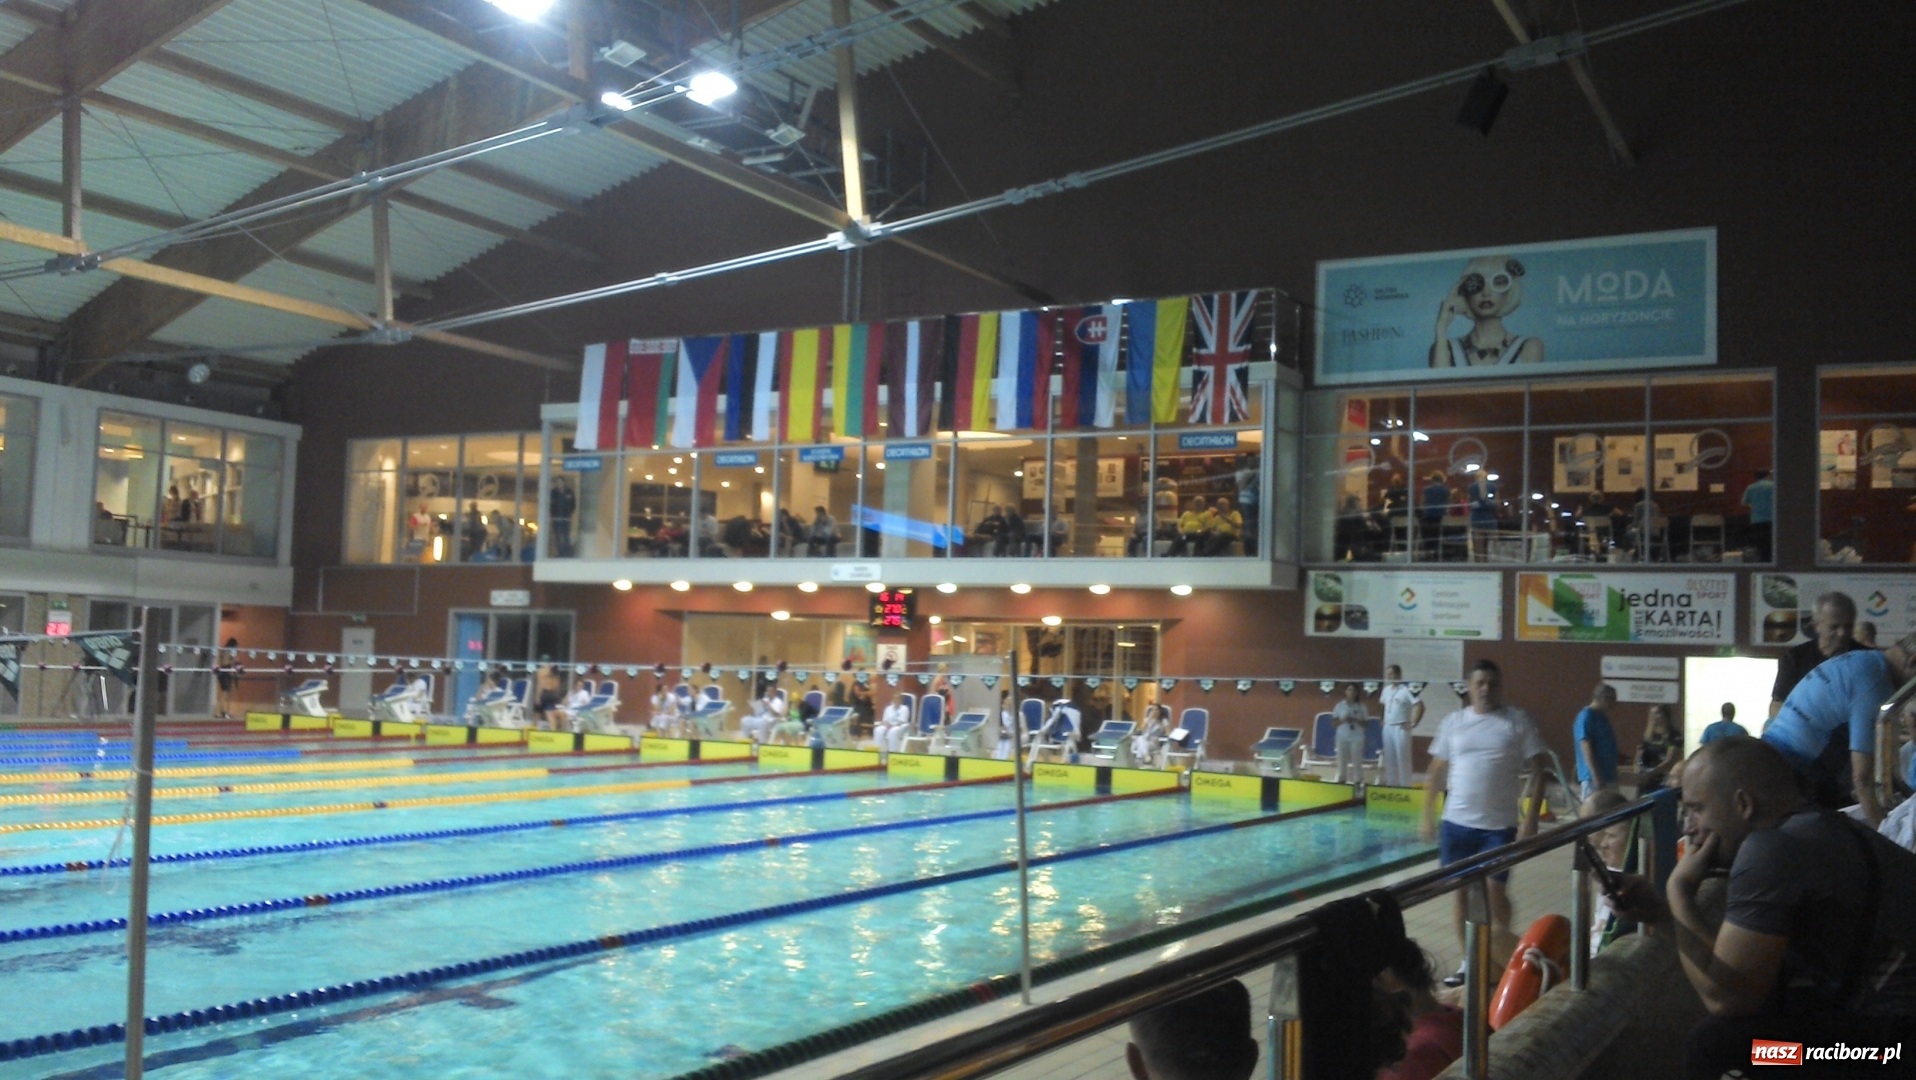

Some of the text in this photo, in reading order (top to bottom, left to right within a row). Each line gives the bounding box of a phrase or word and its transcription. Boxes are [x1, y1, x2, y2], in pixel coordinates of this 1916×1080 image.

[1618, 588, 1692, 611] jedna
[1644, 610, 1722, 638] KARTA!
[1195, 777, 1232, 788] OMEGA
[1369, 792, 1411, 803] OMEGA
